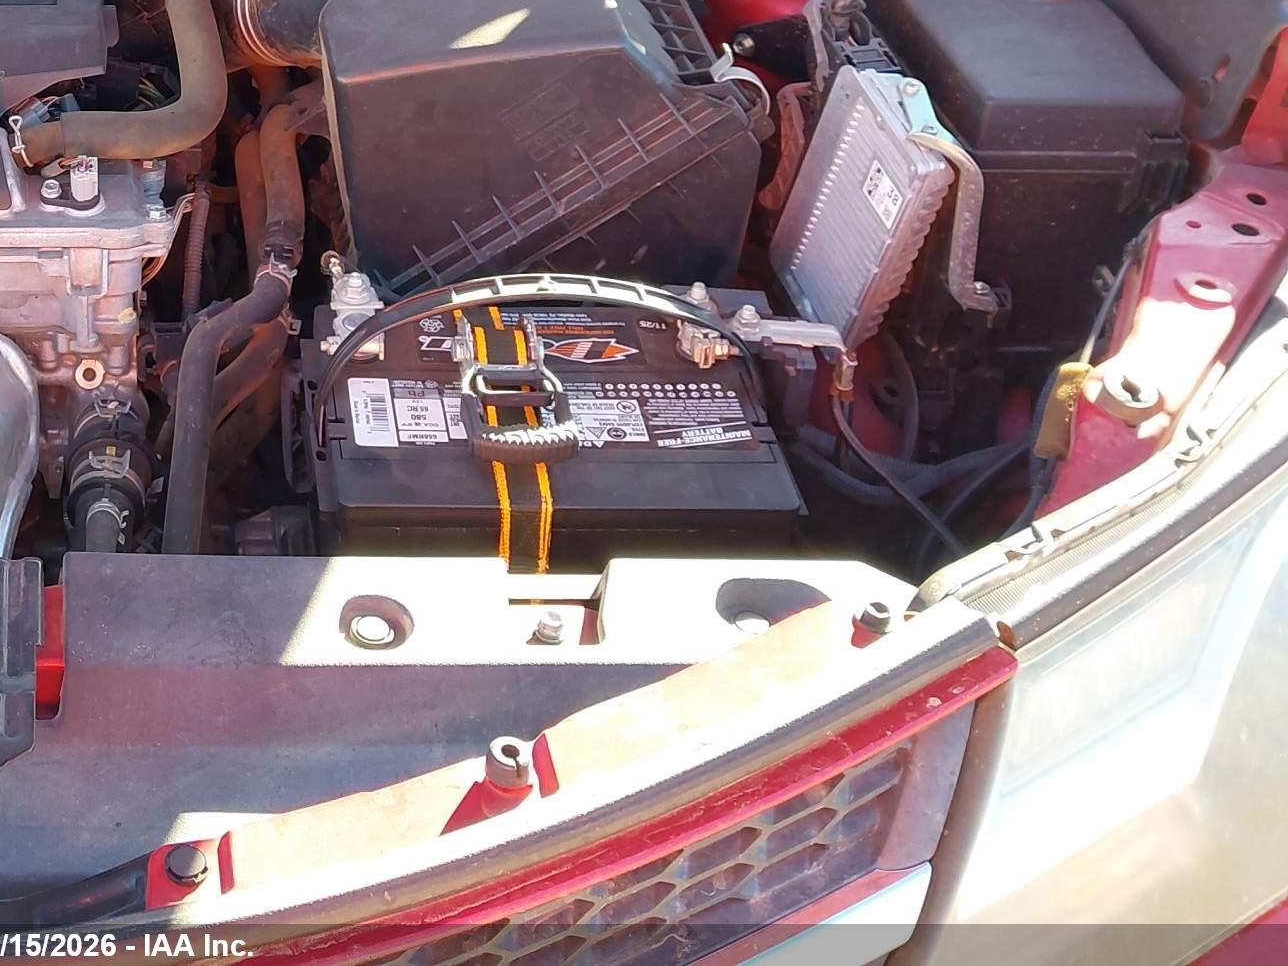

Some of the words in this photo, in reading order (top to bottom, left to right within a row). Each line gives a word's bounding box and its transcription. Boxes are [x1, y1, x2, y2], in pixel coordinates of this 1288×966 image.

[638, 319, 668, 330] 11/25
[656, 429, 752, 447] MAINTENANCE-FREE
[681, 426, 724, 438] BATTERY
